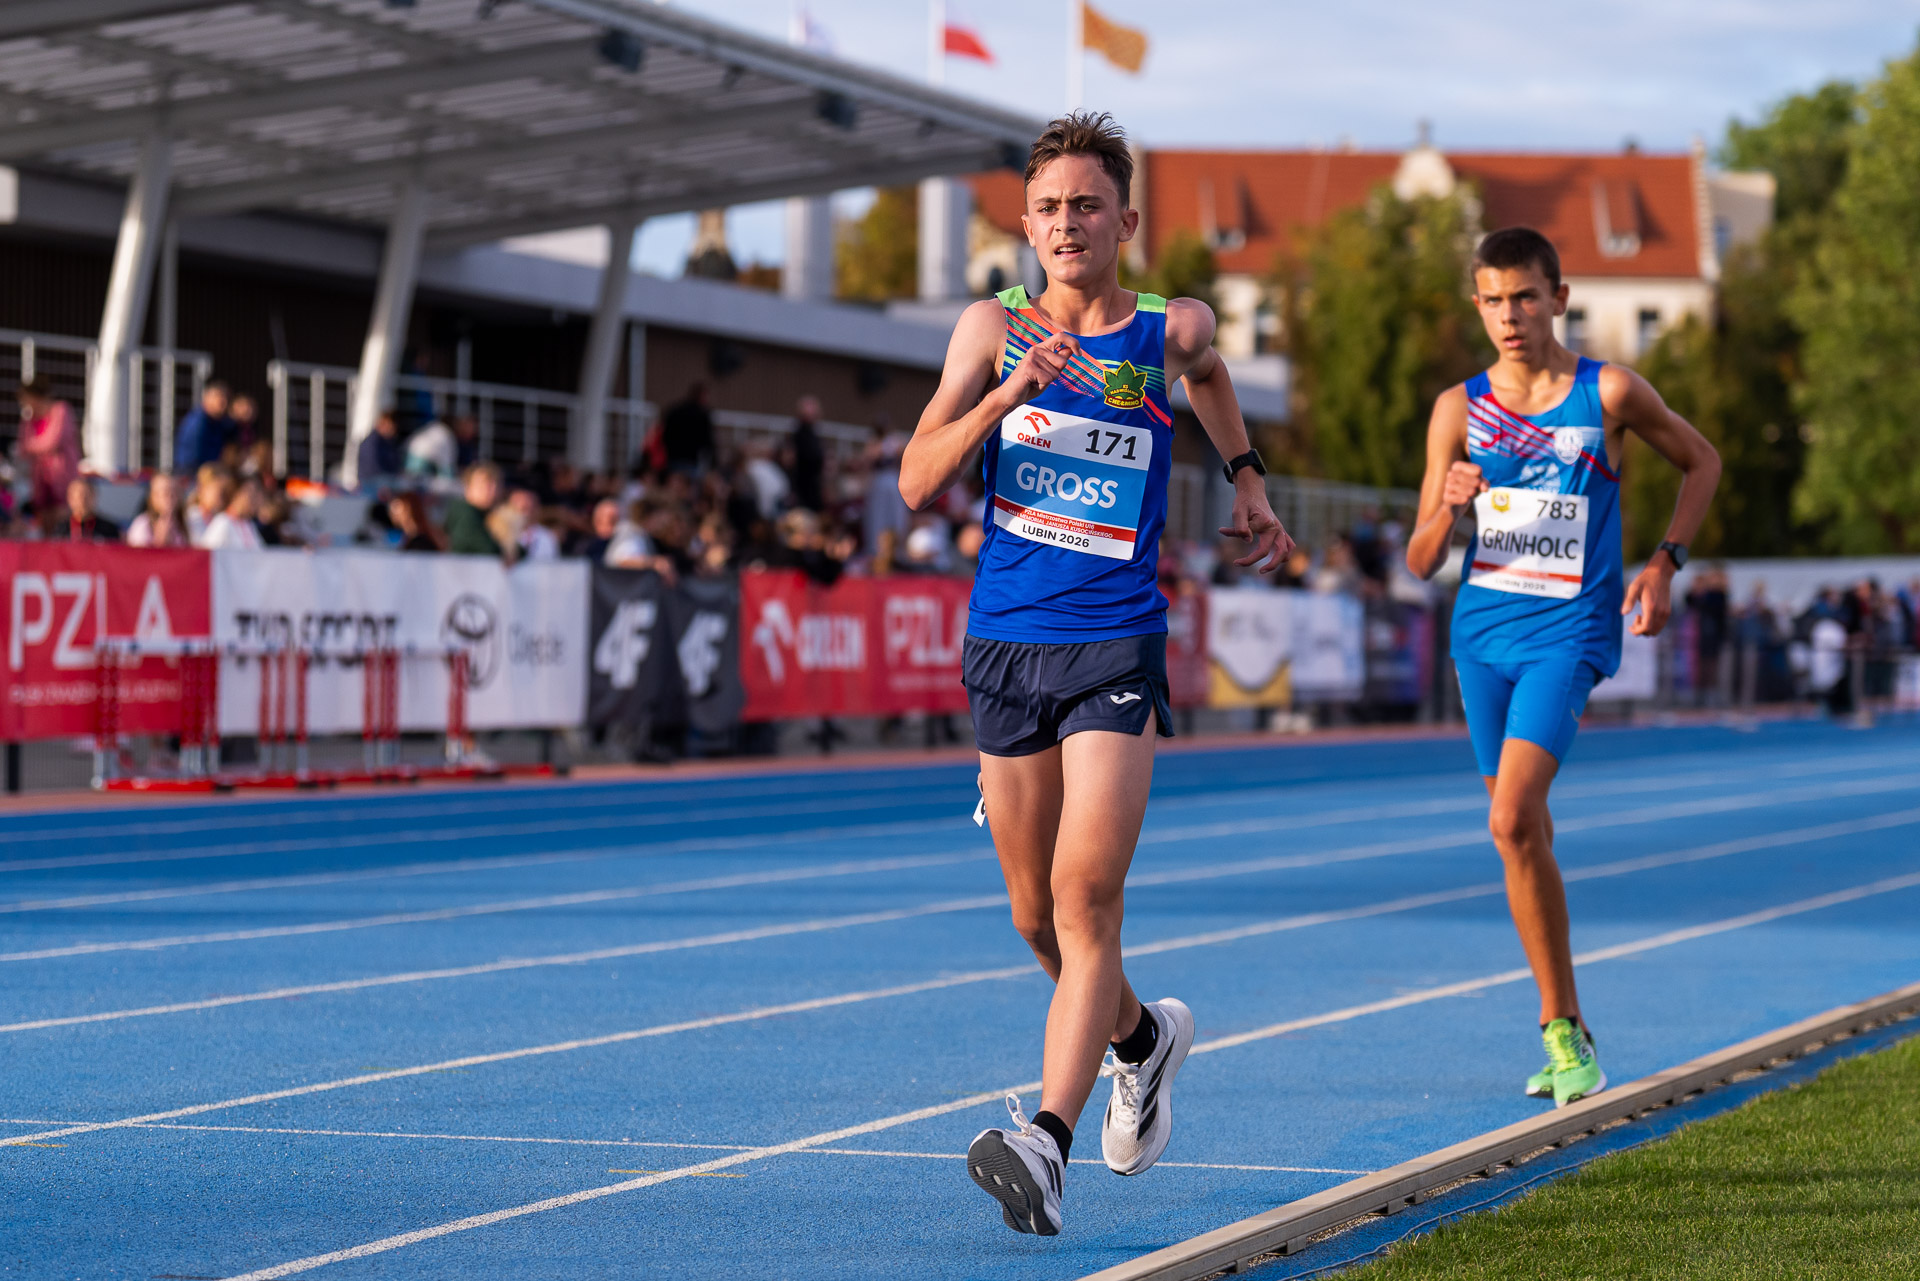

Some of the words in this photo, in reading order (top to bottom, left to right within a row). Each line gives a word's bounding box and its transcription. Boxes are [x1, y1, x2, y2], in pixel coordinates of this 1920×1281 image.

[1017, 432, 1052, 449] ORLEN
[1085, 429, 1137, 461] 171
[1015, 461, 1119, 509] GROSS
[1036, 511, 1068, 524] Mistrzostwa
[1068, 520, 1085, 528] Polski
[1536, 499, 1577, 520] 783
[1022, 523, 1057, 541] LUBIN
[1058, 533, 1090, 548] 2026
[1045, 520, 1069, 530] JANUSZA
[1482, 528, 1579, 560] GRINHOLC
[10, 572, 180, 670] PZLA
[594, 600, 658, 690] 4F
